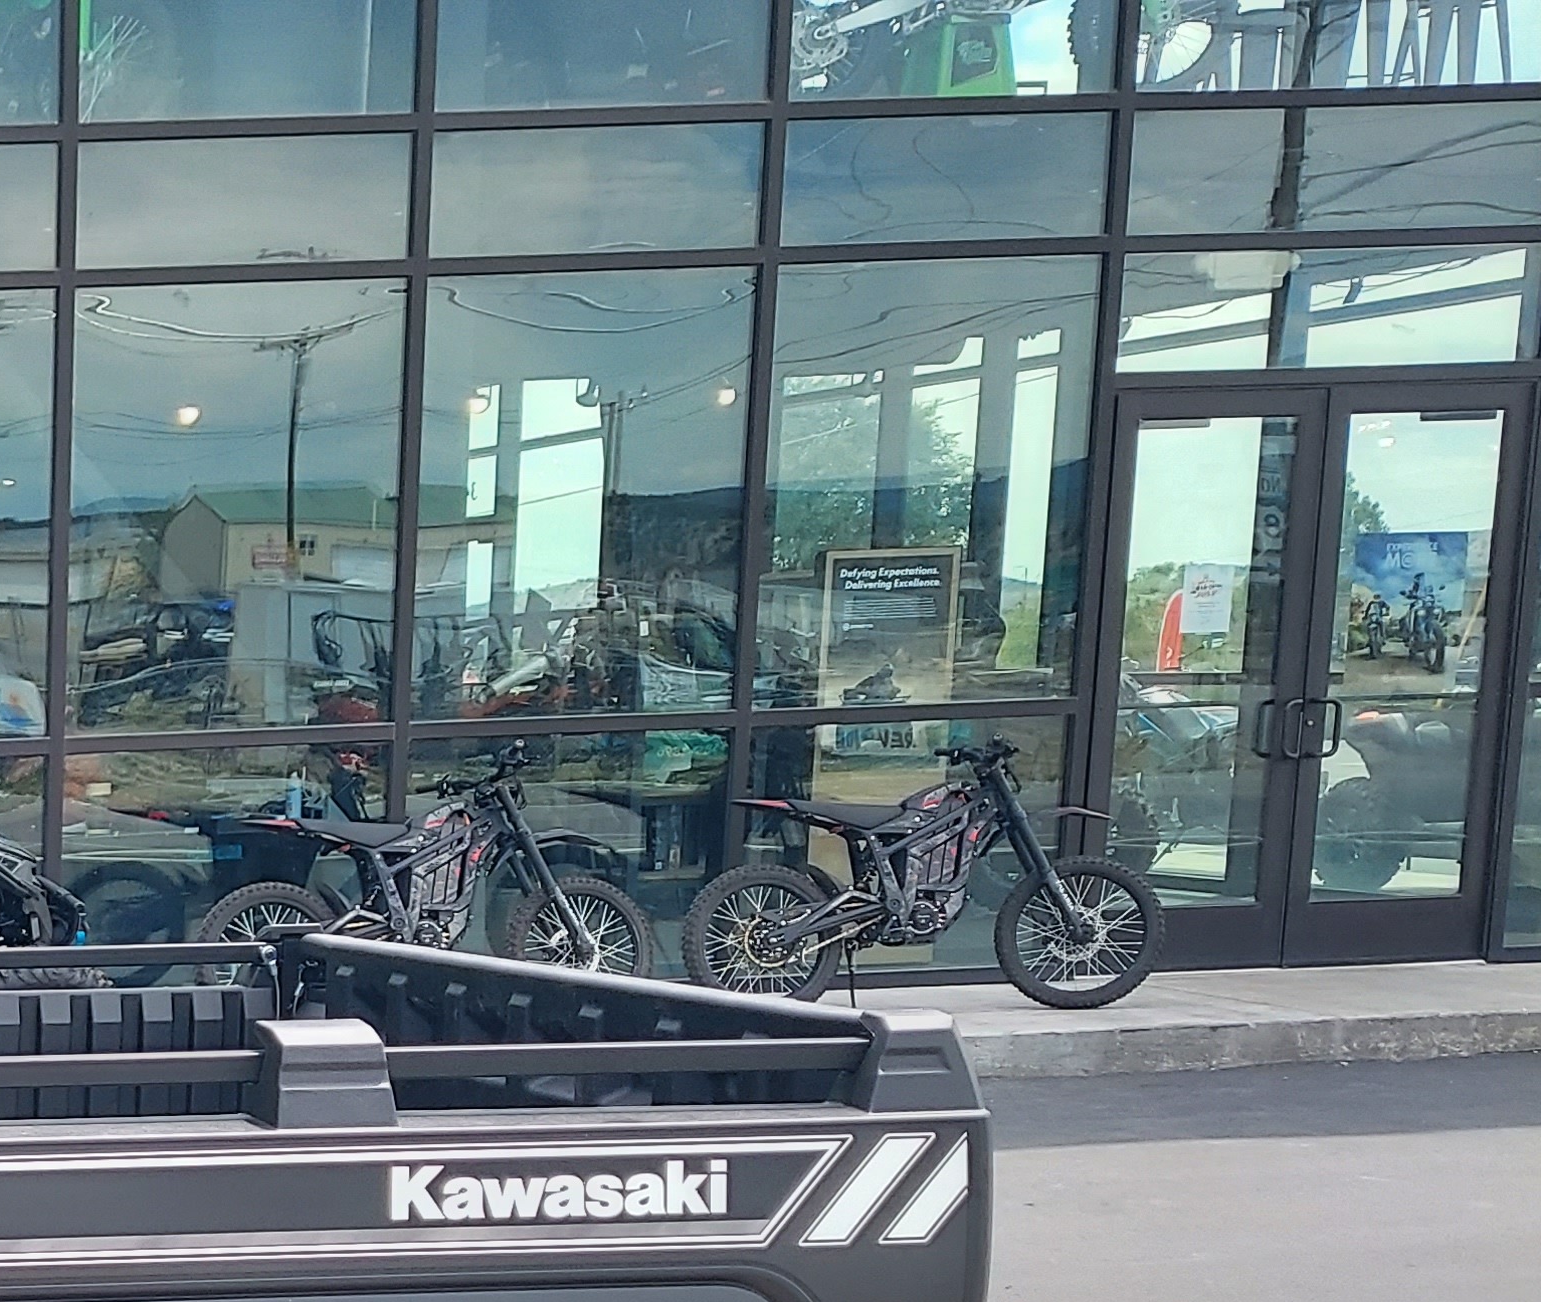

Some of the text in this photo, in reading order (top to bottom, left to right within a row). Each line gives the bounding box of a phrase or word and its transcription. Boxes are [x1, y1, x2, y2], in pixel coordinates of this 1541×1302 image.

[839, 565, 940, 579] Defying Expectations.
[844, 580, 892, 591] Delivering
[390, 1158, 729, 1221] Kawasaki
